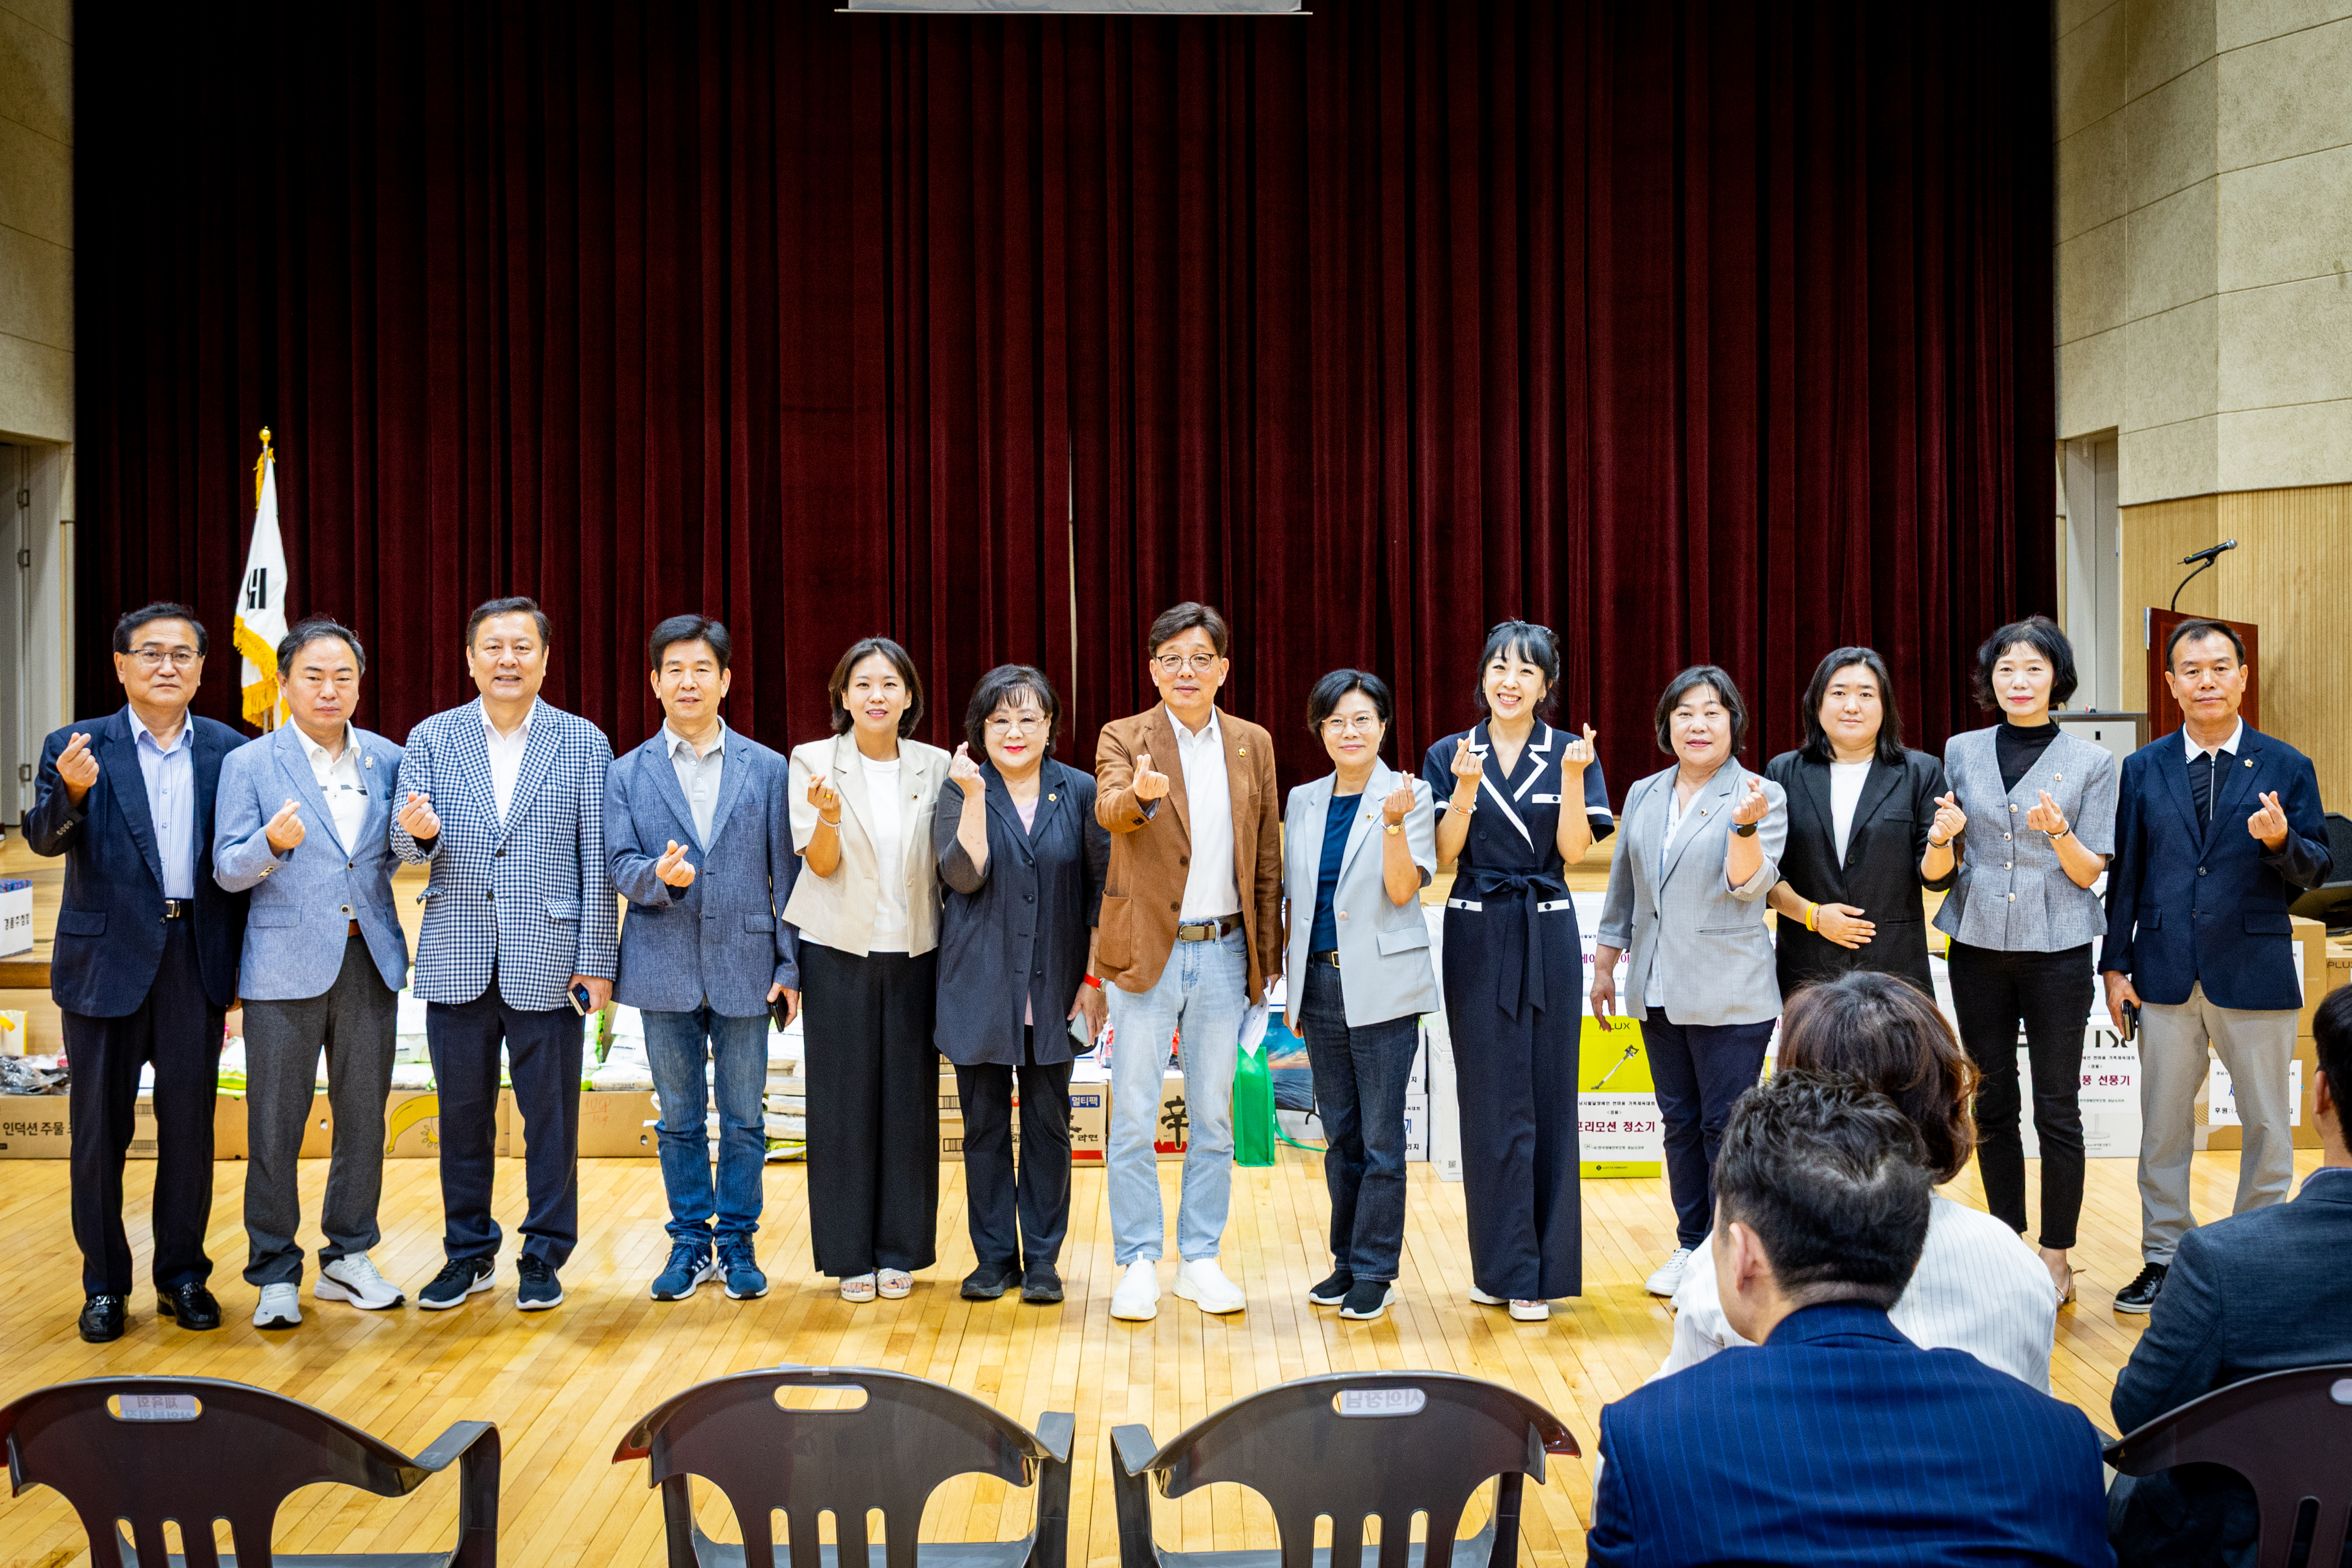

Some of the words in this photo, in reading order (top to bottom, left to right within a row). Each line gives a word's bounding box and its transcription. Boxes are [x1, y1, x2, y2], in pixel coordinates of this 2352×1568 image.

[2098, 1075, 2129, 1086] 선풍기
[1072, 1096, 1098, 1107] 멀티팩
[3, 1122, 38, 1136] 인덕션
[41, 1122, 64, 1136] 주물
[1623, 1121, 1655, 1132] 청소기
[1078, 1134, 1099, 1143] 라면
